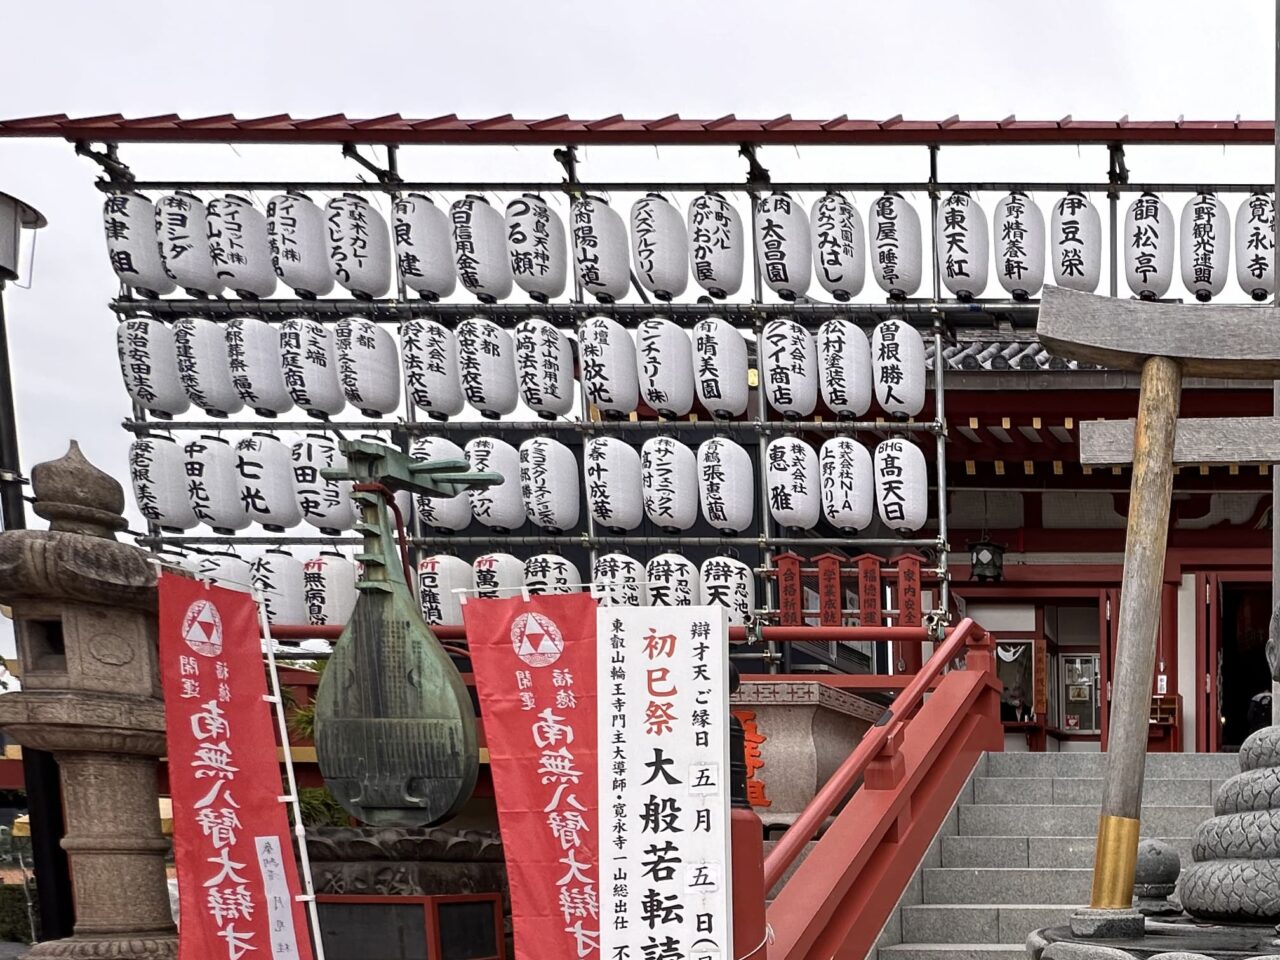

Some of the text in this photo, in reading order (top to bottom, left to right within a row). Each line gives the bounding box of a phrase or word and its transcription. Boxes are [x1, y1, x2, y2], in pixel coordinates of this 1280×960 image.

[105, 196, 139, 274] 根津組
[328, 197, 350, 283] とくじろう
[506, 199, 535, 277] つる瀬
[533, 205, 550, 276] 湯島天神下
[693, 196, 717, 282] ながおか屋
[713, 199, 731, 249] 下町バル
[816, 196, 844, 283] あんみつみはし
[876, 197, 900, 284] 亀屋一睡亭
[1002, 196, 1028, 280] 上野精養軒
[1132, 198, 1159, 284] 韻松亭
[1192, 196, 1216, 285] 上野観光連盟
[1247, 197, 1269, 279] 寛永寺
[127, 321, 157, 402] 明治安田生命
[305, 324, 328, 368] 池之端
[357, 322, 376, 349] 京都
[403, 322, 432, 407] 鈴木法衣店
[426, 325, 447, 375] 株式会社
[458, 322, 486, 404] 森忠法衣店
[480, 324, 500, 358] 京都
[766, 321, 792, 405] クマイ商店
[790, 323, 806, 377] 株式会社
[822, 320, 848, 405] 松村塗装店
[184, 441, 216, 522] 中田光広
[791, 443, 808, 495] 株式会社
[821, 447, 840, 519] 上野のり子
[878, 442, 903, 454] BHG
[641, 627, 679, 736] 初巳祭
